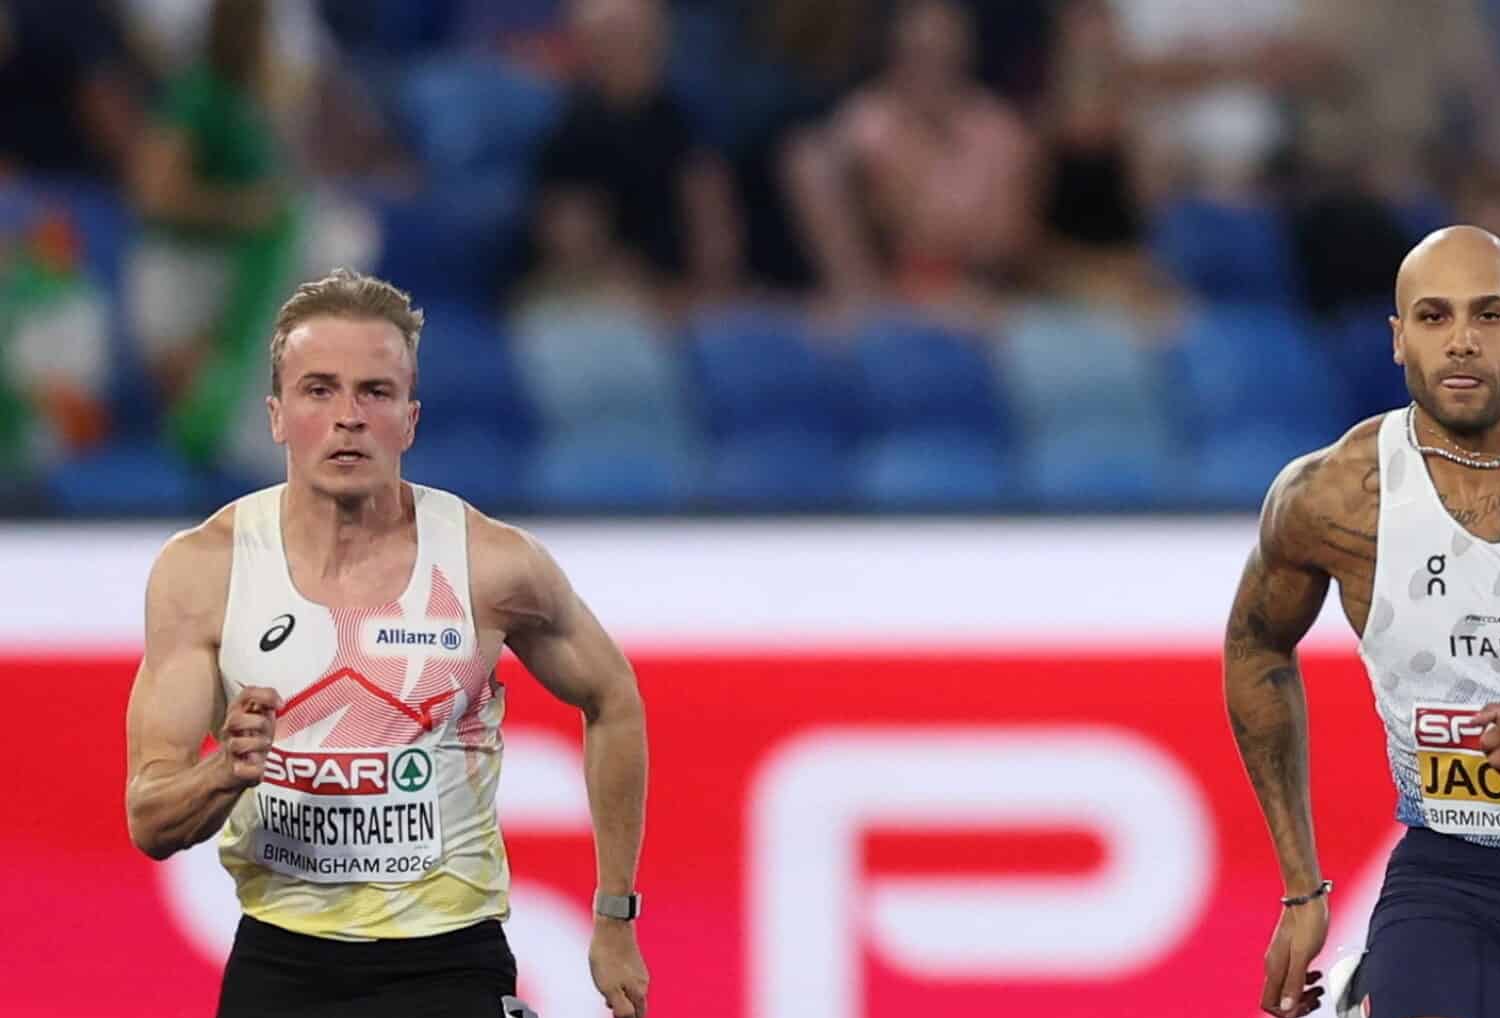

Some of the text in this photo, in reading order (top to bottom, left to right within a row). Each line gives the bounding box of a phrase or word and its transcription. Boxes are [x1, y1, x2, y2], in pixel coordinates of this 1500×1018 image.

[376, 629, 437, 645] Allianz
[264, 752, 385, 789] SPAR
[258, 792, 434, 846] VERHERSTRAETEN
[263, 843, 433, 874] BIRMINGHAM 2026
